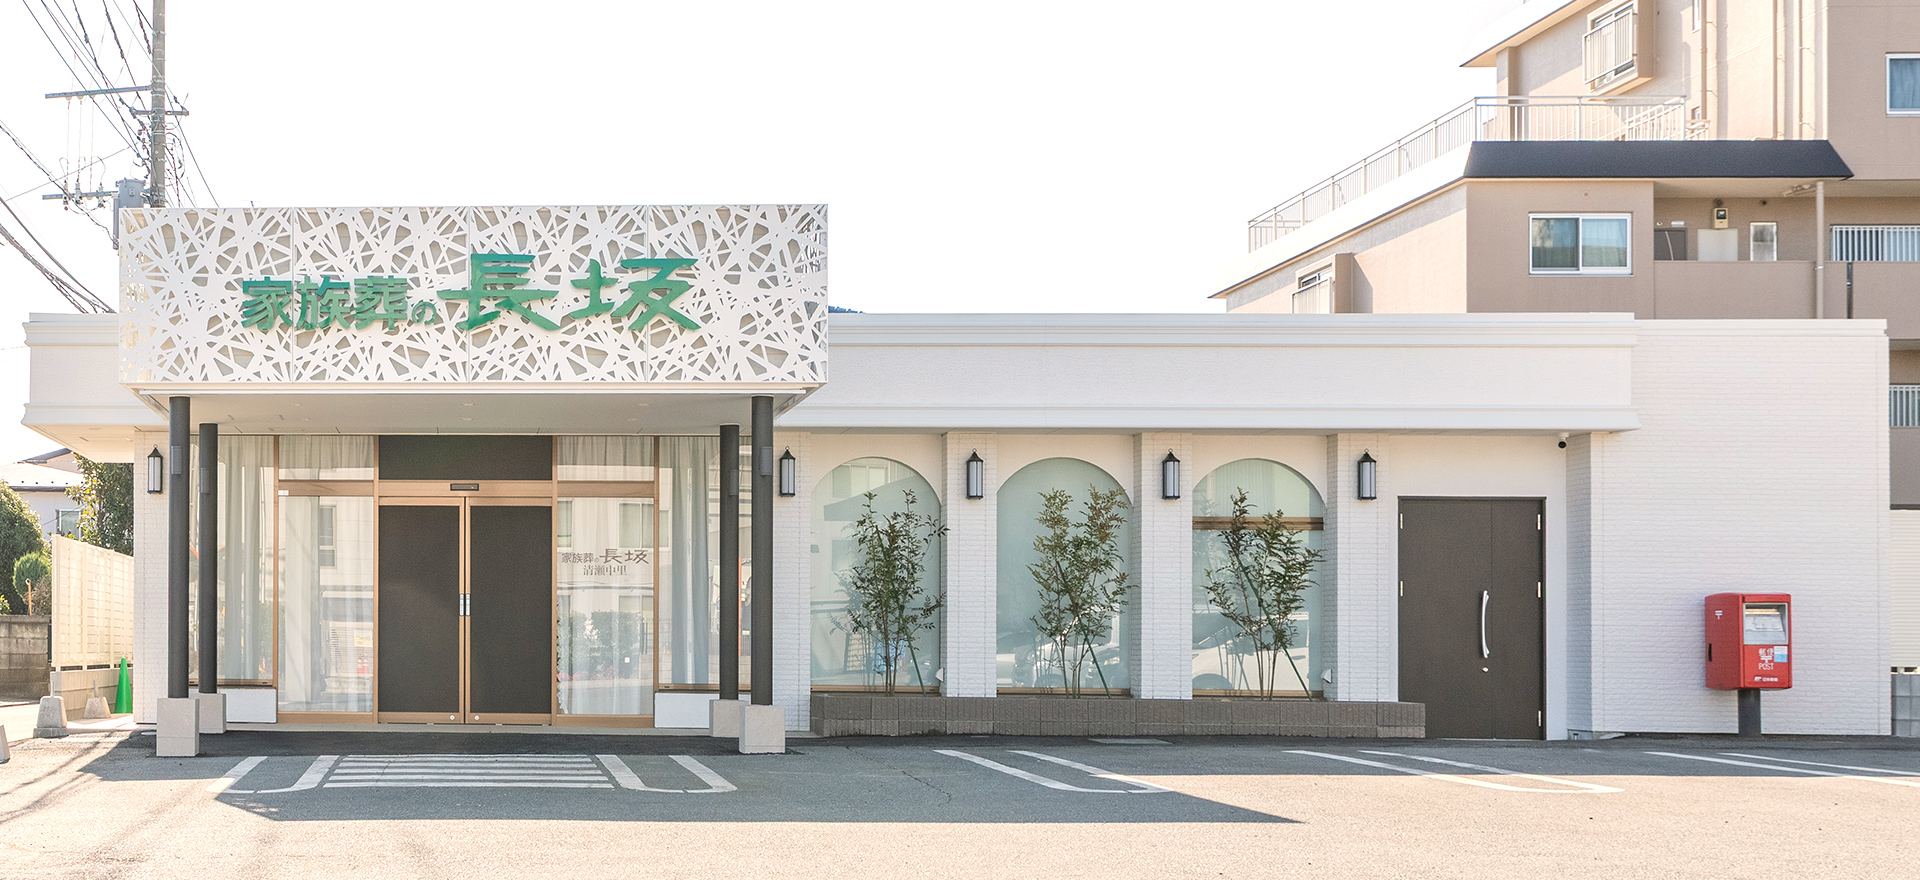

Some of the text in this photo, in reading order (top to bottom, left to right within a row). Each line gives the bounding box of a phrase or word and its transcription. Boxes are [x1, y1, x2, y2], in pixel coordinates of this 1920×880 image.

[240, 253, 701, 331] 家族葬の長坂
[561, 548, 649, 564] 家族葬の長坂
[583, 565, 627, 576] 清瀬中里
[1758, 662, 1774, 670] POST
